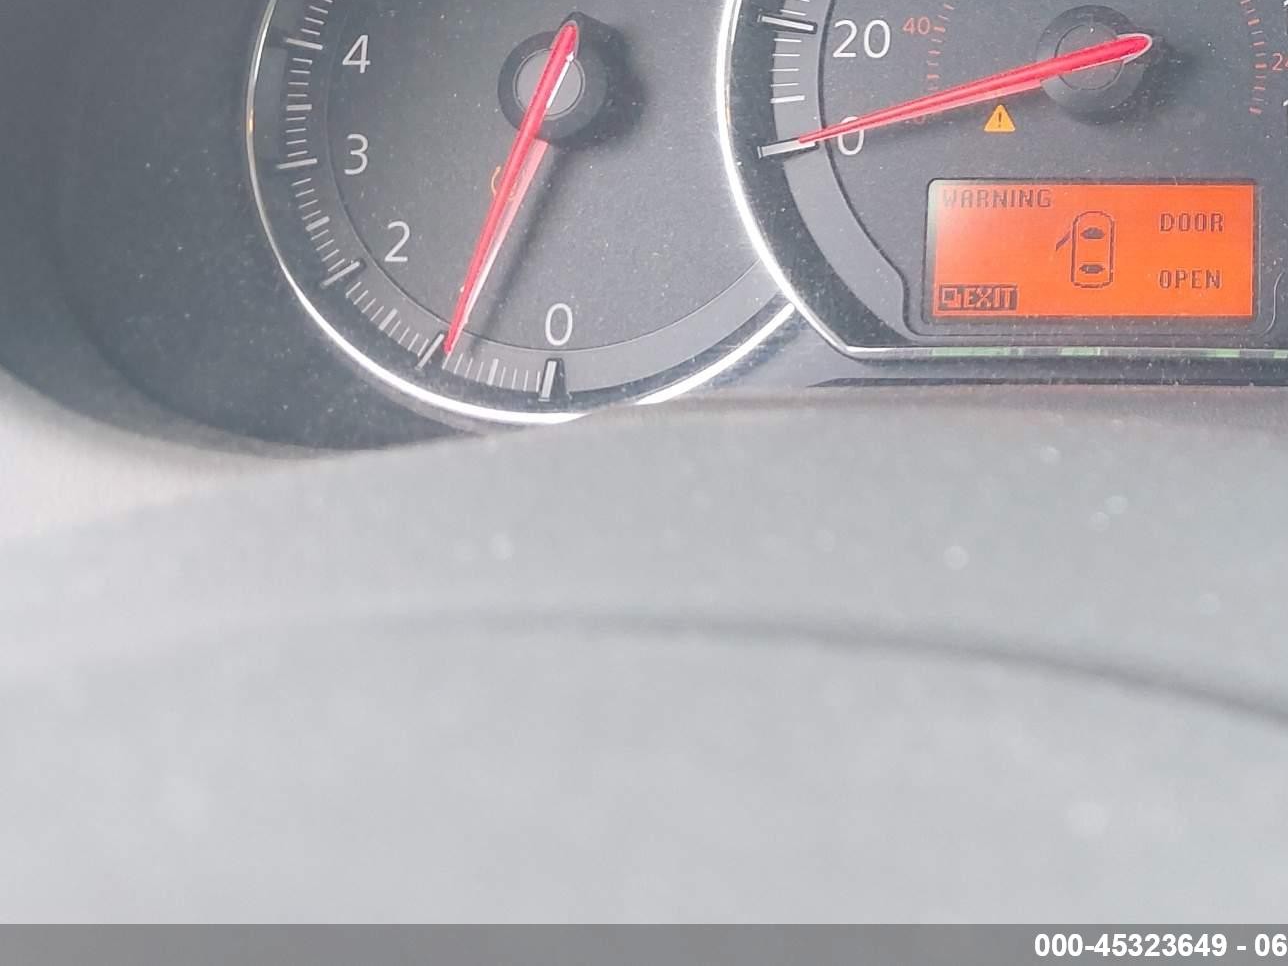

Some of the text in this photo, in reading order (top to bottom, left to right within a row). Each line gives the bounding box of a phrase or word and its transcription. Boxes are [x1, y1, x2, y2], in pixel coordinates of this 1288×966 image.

[833, 20, 892, 59] 20
[903, 17, 931, 35] 40
[342, 35, 371, 74] 4
[345, 134, 370, 174] 3
[837, 117, 865, 155] 0
[941, 188, 1052, 209] WARNING
[1159, 212, 1225, 233] DOOR
[385, 222, 412, 263] 2
[962, 287, 1017, 309] EXIT
[1158, 268, 1222, 290] OPEN
[545, 303, 573, 346] 0
